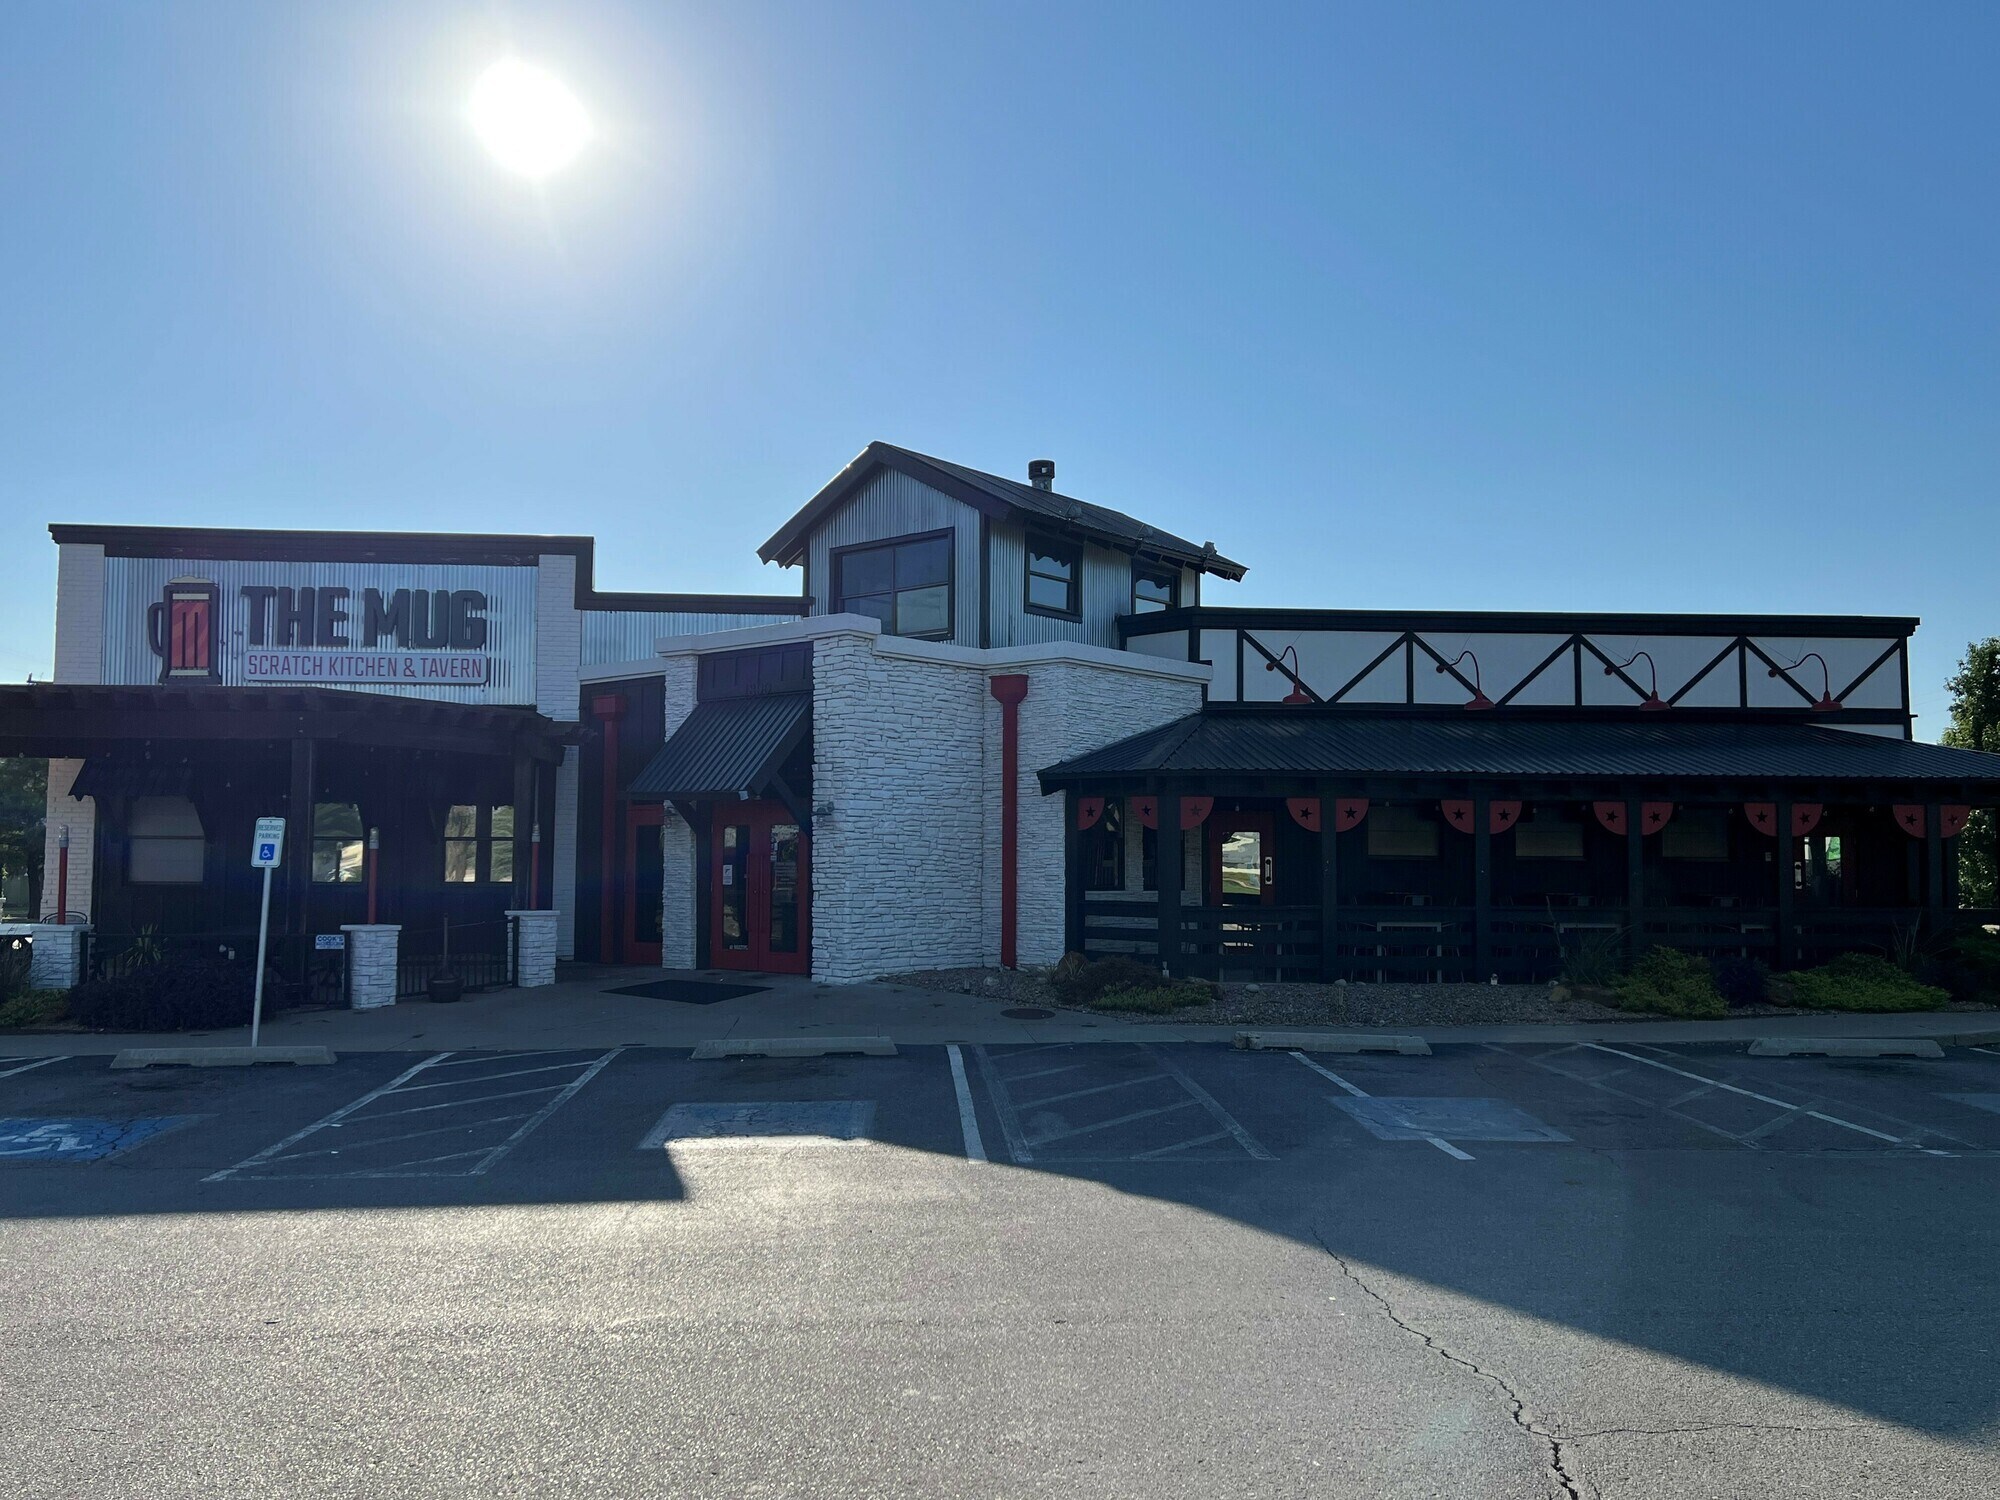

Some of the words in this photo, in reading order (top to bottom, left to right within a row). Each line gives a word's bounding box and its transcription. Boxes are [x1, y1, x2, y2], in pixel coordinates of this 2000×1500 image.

[240, 585, 350, 647] THE
[364, 587, 488, 650] MUG
[249, 654, 323, 676] SCRATCH
[329, 655, 398, 677] KITCHEN
[403, 656, 417, 678] &
[420, 657, 482, 678] TAVERN
